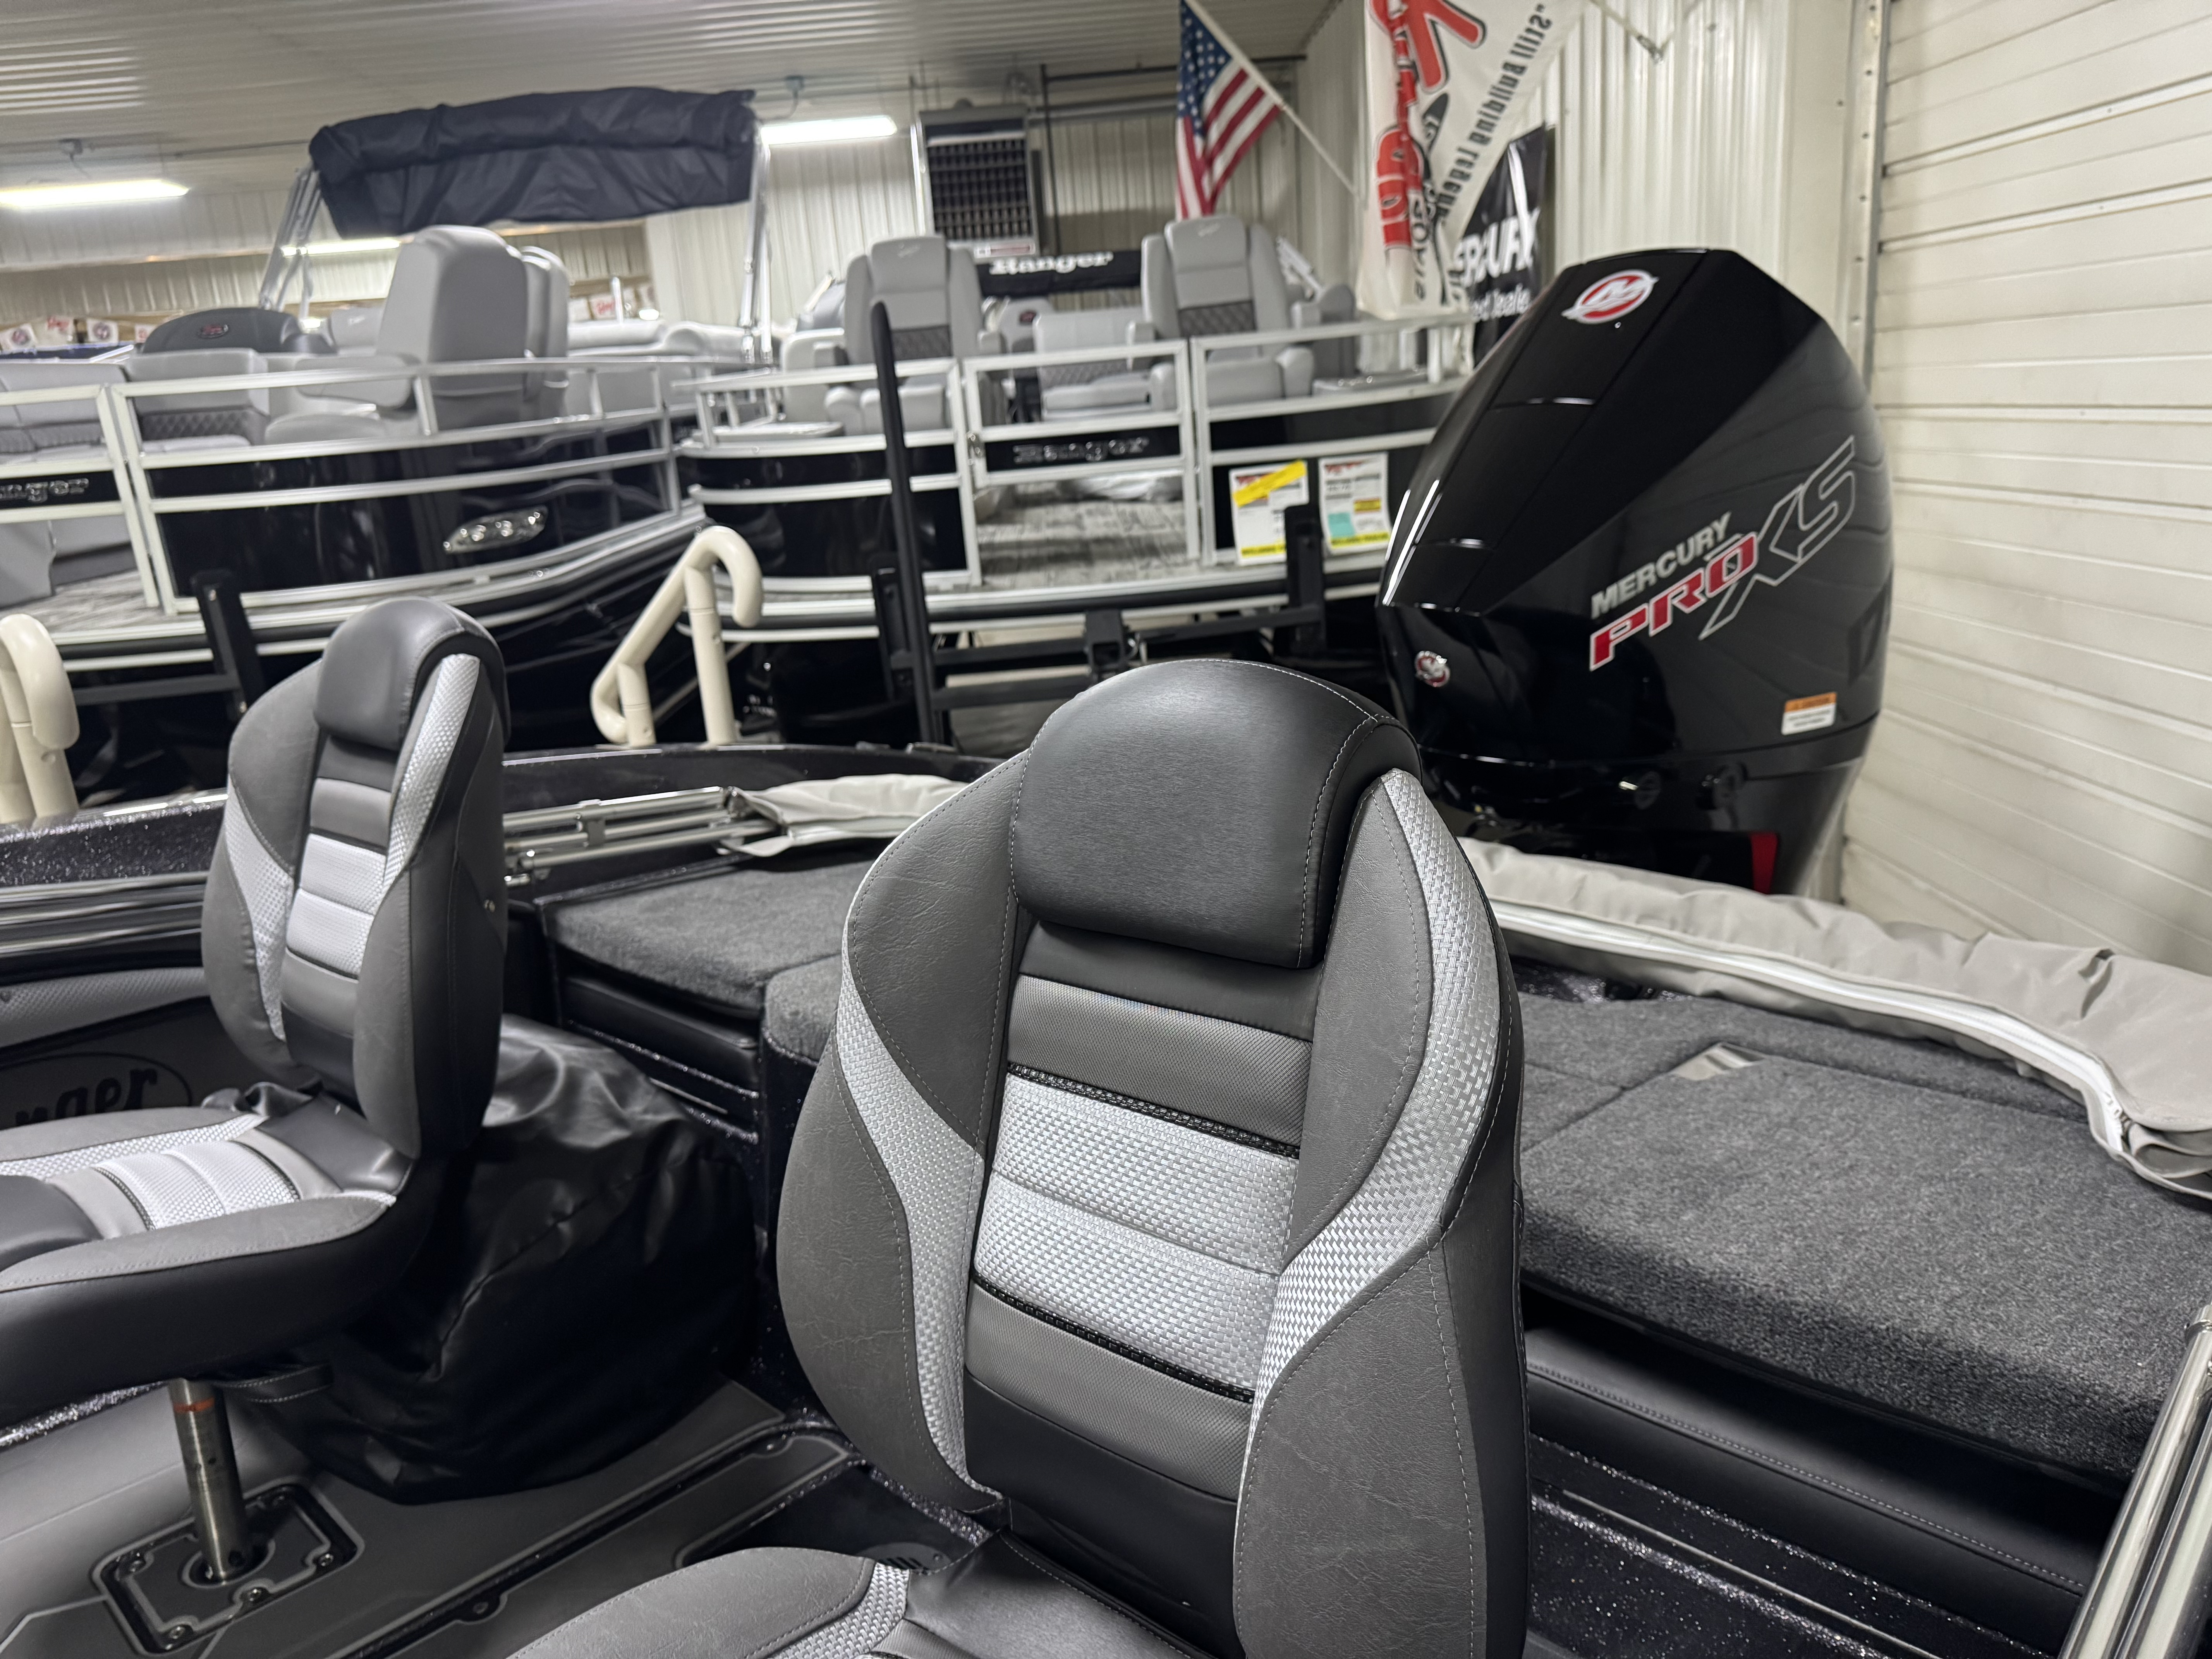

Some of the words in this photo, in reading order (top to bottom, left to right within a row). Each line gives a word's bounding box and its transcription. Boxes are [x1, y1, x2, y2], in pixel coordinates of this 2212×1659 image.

[989, 251, 1114, 275] Ranger
[1454, 206, 1541, 288] ERCURY
[1590, 531, 1759, 672] PRO
[1698, 434, 1856, 641] XS
[1591, 511, 1732, 620] MERCURY
